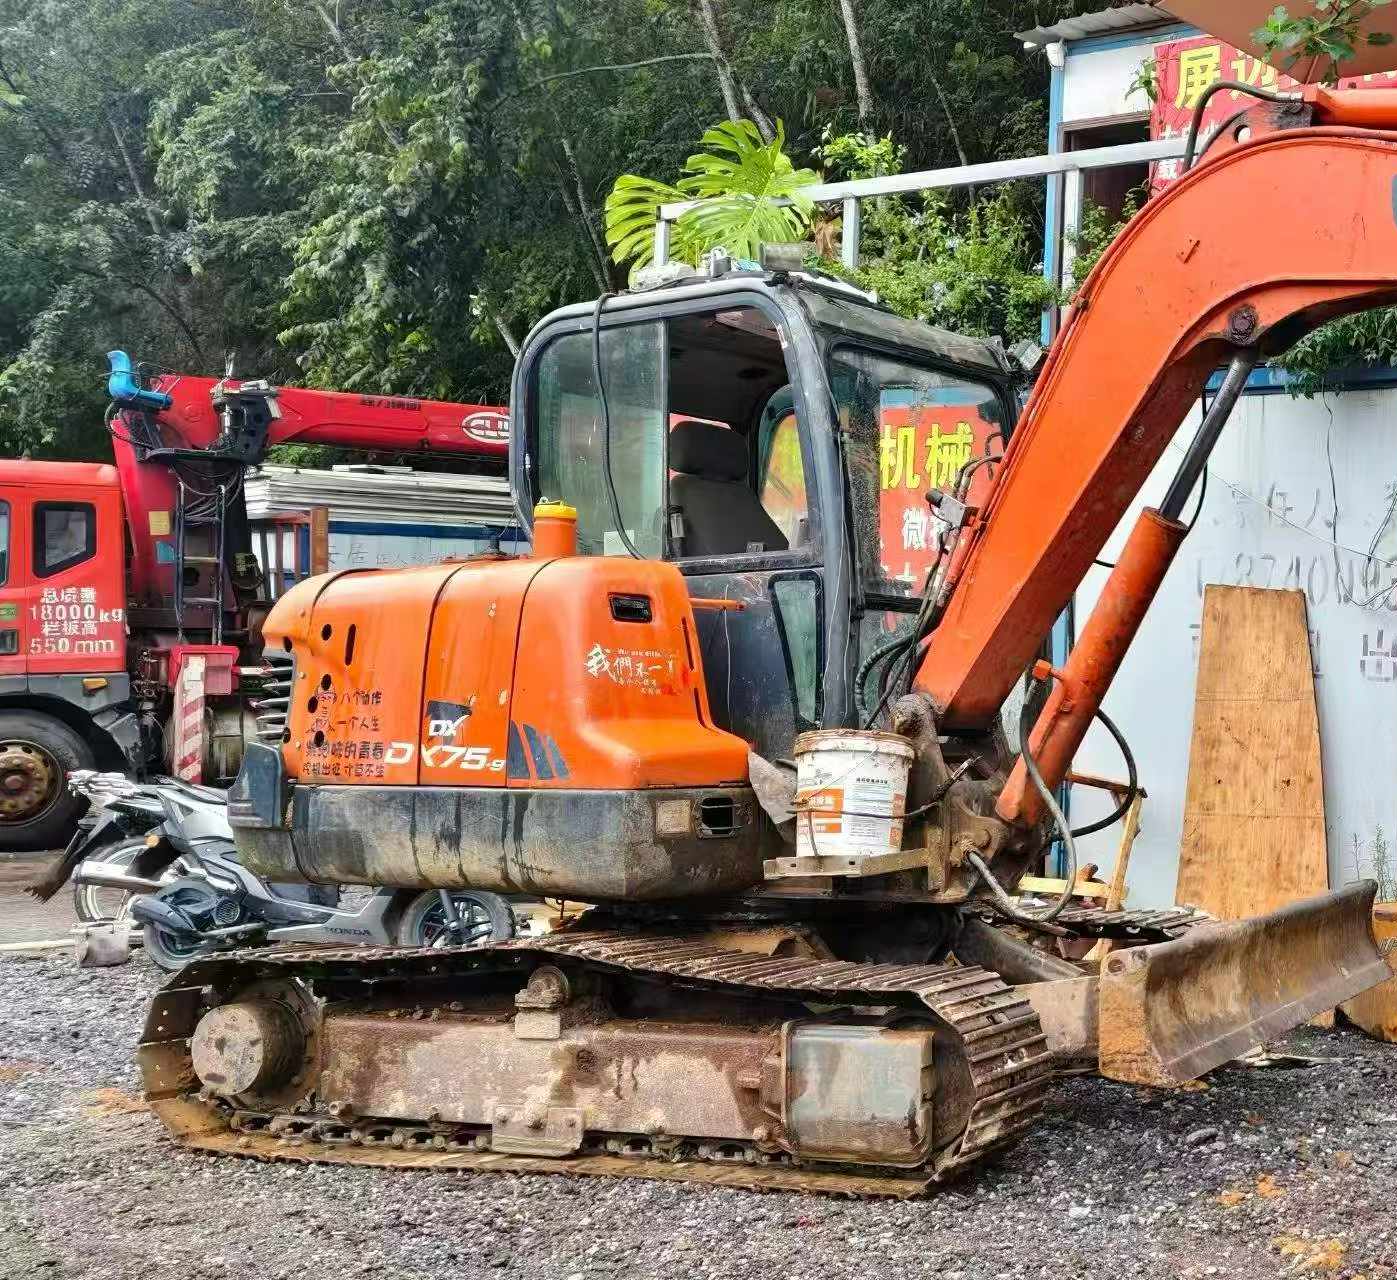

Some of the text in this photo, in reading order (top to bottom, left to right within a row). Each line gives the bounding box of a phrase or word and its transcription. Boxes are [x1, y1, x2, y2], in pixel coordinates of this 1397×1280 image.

[880, 422, 974, 490] 机械
[40, 586, 97, 604] 总质量
[429, 713, 470, 736] DX
